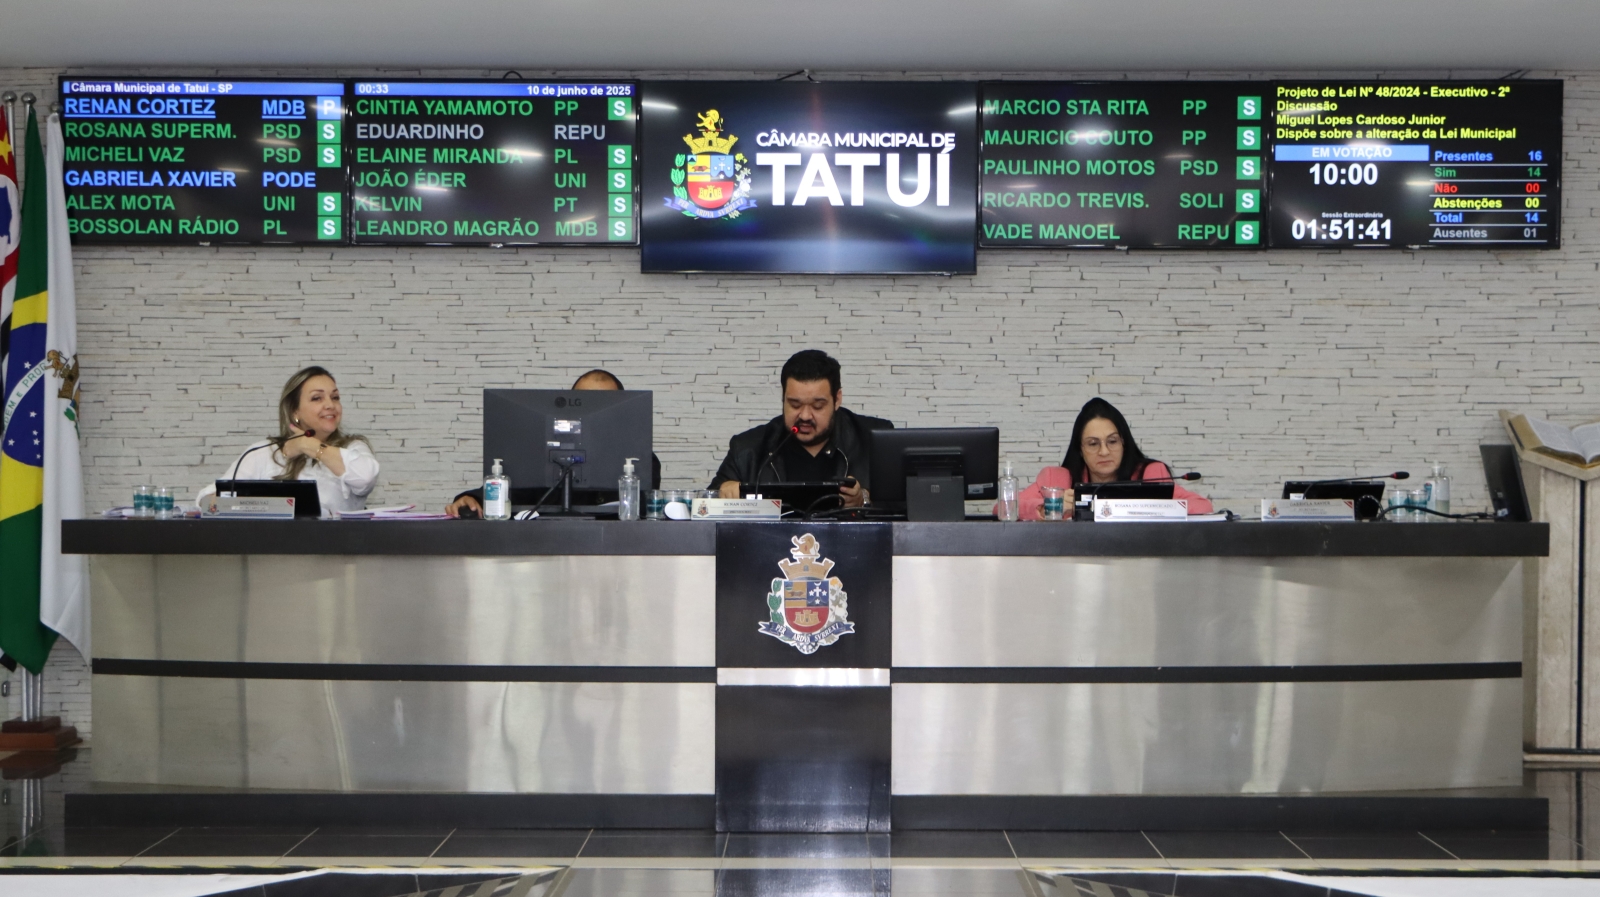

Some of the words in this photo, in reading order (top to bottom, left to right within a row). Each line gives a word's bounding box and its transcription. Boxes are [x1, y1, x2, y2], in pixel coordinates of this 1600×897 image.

[71, 82, 112, 93] Câmara
[114, 83, 166, 94] Municipal
[168, 84, 180, 93] de
[183, 83, 209, 93] Tatuí
[218, 84, 232, 93] SP
[359, 84, 388, 94] 00:33
[527, 86, 539, 96] 10
[542, 86, 554, 96] de
[556, 86, 588, 98] junho
[590, 86, 603, 96] de
[606, 86, 631, 96] 2025
[1276, 87, 1318, 98] Projeto
[1322, 87, 1336, 97] de
[1339, 87, 1356, 97] Lei
[1360, 87, 1373, 98] Nº
[1376, 87, 1420, 98] 48/2024
[1430, 87, 1488, 98] Executivo
[1498, 87, 1510, 98] 2ª
[65, 98, 131, 114] RENAN
[136, 99, 216, 115] CORTEZ
[262, 100, 306, 116] MDB
[324, 100, 336, 116] P
[356, 100, 419, 115] CINTIA
[423, 100, 533, 116] YAMAMOTO
[554, 101, 578, 116] PP
[614, 101, 626, 116] S
[984, 100, 1060, 115] MARCIO
[1066, 100, 1102, 115] STA
[1107, 100, 1149, 115] RITA
[1182, 100, 1207, 115] PP
[1243, 100, 1256, 116] S
[1276, 102, 1338, 112] Discussão
[1276, 115, 1314, 126] Miguel
[1318, 115, 1353, 126] Lopes
[1356, 115, 1405, 125] Cardoso
[1408, 115, 1446, 125] Junior
[65, 122, 146, 138] ROSANA
[151, 124, 236, 138] SUPERM.
[263, 124, 301, 139] PSD
[323, 124, 336, 140] S
[356, 124, 484, 140] EDUARDINHO
[554, 125, 606, 140] REPU
[756, 129, 832, 148] CÂMARA
[834, 132, 928, 148] MUNICIPAL
[932, 132, 956, 148] DE
[984, 130, 1078, 146] MAURICIO
[1084, 130, 1154, 146] COUTO
[1182, 131, 1206, 145] PP
[1243, 130, 1255, 146] S
[1276, 128, 1316, 140] Dispõe
[1320, 129, 1352, 139] sobre
[1356, 131, 1362, 139] a
[1366, 129, 1420, 141] alteração
[1422, 129, 1437, 139] da
[1440, 129, 1458, 139] Lei
[1460, 129, 1516, 140] Municipal
[65, 147, 142, 162] MICHELI
[148, 147, 185, 162] VAZ
[263, 148, 301, 163] PSD
[323, 148, 336, 164] S
[356, 148, 426, 164] ELAINE
[433, 148, 523, 164] MIRANDA
[554, 149, 578, 164] PL
[614, 148, 626, 164] S
[1312, 148, 1330, 158] EM
[1333, 146, 1392, 159] VOTAÇÃO
[1434, 151, 1493, 162] Presentes
[1528, 151, 1542, 162] 16
[756, 144, 956, 206] TATUÍ
[984, 160, 1080, 176] PAULINHO
[1086, 160, 1156, 176] MOTOS
[1180, 160, 1218, 176] PSD
[1242, 160, 1254, 176] S
[1310, 163, 1378, 185] 10:00
[1434, 167, 1456, 178] Sim
[1528, 168, 1541, 177] 14
[65, 170, 164, 186] GABRIELA
[167, 171, 236, 186] XAVIER
[262, 172, 316, 188] PODE
[356, 168, 408, 187] JOÃO
[415, 168, 466, 188] ÉDER
[554, 173, 586, 188] UNI
[614, 173, 626, 188] S
[1434, 182, 1458, 194] Não
[1526, 183, 1540, 193] 00
[66, 195, 116, 210] ALEX
[121, 196, 175, 210] MOTA
[264, 196, 295, 211] UNI
[323, 196, 336, 212] S
[356, 196, 422, 212] KELVIN
[554, 197, 578, 212] PT
[614, 197, 626, 212] S
[984, 192, 1071, 208] RICARDO
[1077, 193, 1149, 208] TREVIS.
[1180, 193, 1224, 208] SOLI
[1242, 193, 1254, 208] S
[1434, 198, 1502, 210] Abstenções
[1525, 198, 1540, 208] 00
[1434, 212, 1462, 223] Total
[1525, 212, 1539, 223] 14
[68, 218, 172, 234] BOSSOLAN
[179, 216, 239, 234] RÁDIO
[264, 220, 286, 235] PL
[323, 220, 336, 236] S
[356, 220, 448, 236] LEANDRO
[454, 218, 539, 236] MAGRÃO
[556, 222, 598, 236] MDB
[614, 221, 626, 237] S
[983, 224, 1032, 239] VADE
[1039, 224, 1120, 240] MANOEL
[1178, 225, 1230, 240] REPU
[1241, 224, 1254, 240] S
[1292, 218, 1392, 240] 01:51:41
[1434, 228, 1488, 238] Ausentes
[1524, 228, 1537, 238] 01
[568, 398, 582, 407] LG
[776, 624, 786, 635] PER
